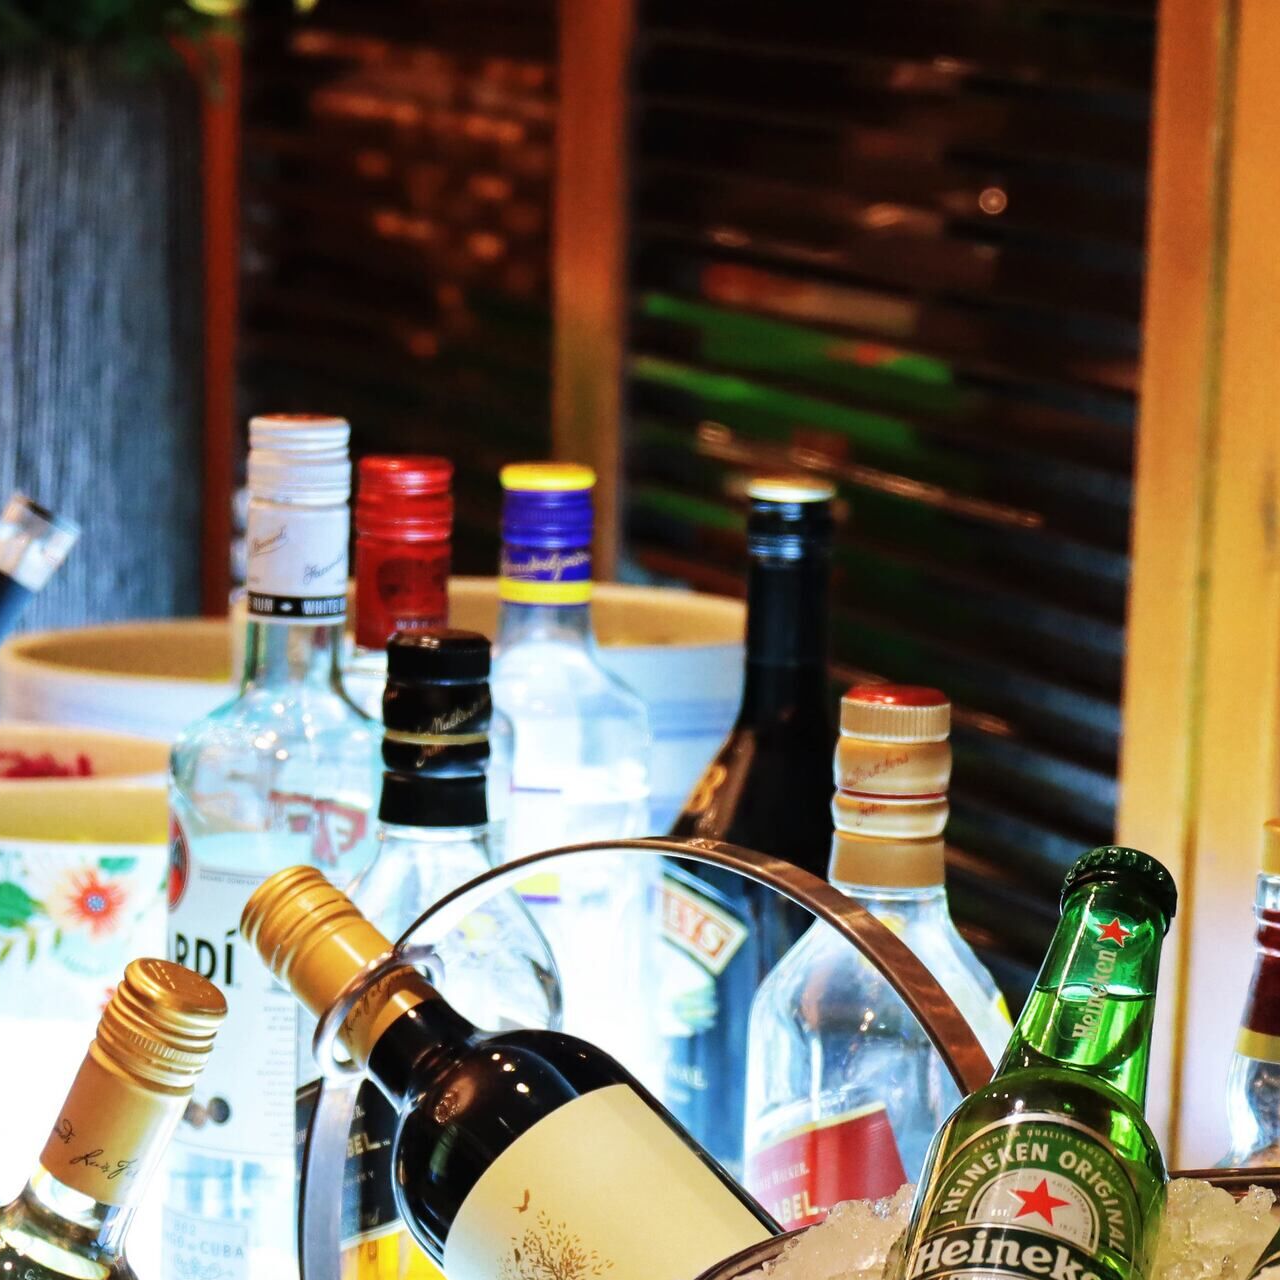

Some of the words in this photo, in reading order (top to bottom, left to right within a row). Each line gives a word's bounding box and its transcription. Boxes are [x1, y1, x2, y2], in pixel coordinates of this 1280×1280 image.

[169, 928, 238, 985] RDÍ
[1072, 949, 1117, 1041] Heineken
[1026, 1129, 1073, 1143] QUALITY
[940, 1142, 1049, 1215] HEINEKEN
[1058, 1151, 1126, 1254] ORIGINAL
[200, 1241, 244, 1259] CUBA
